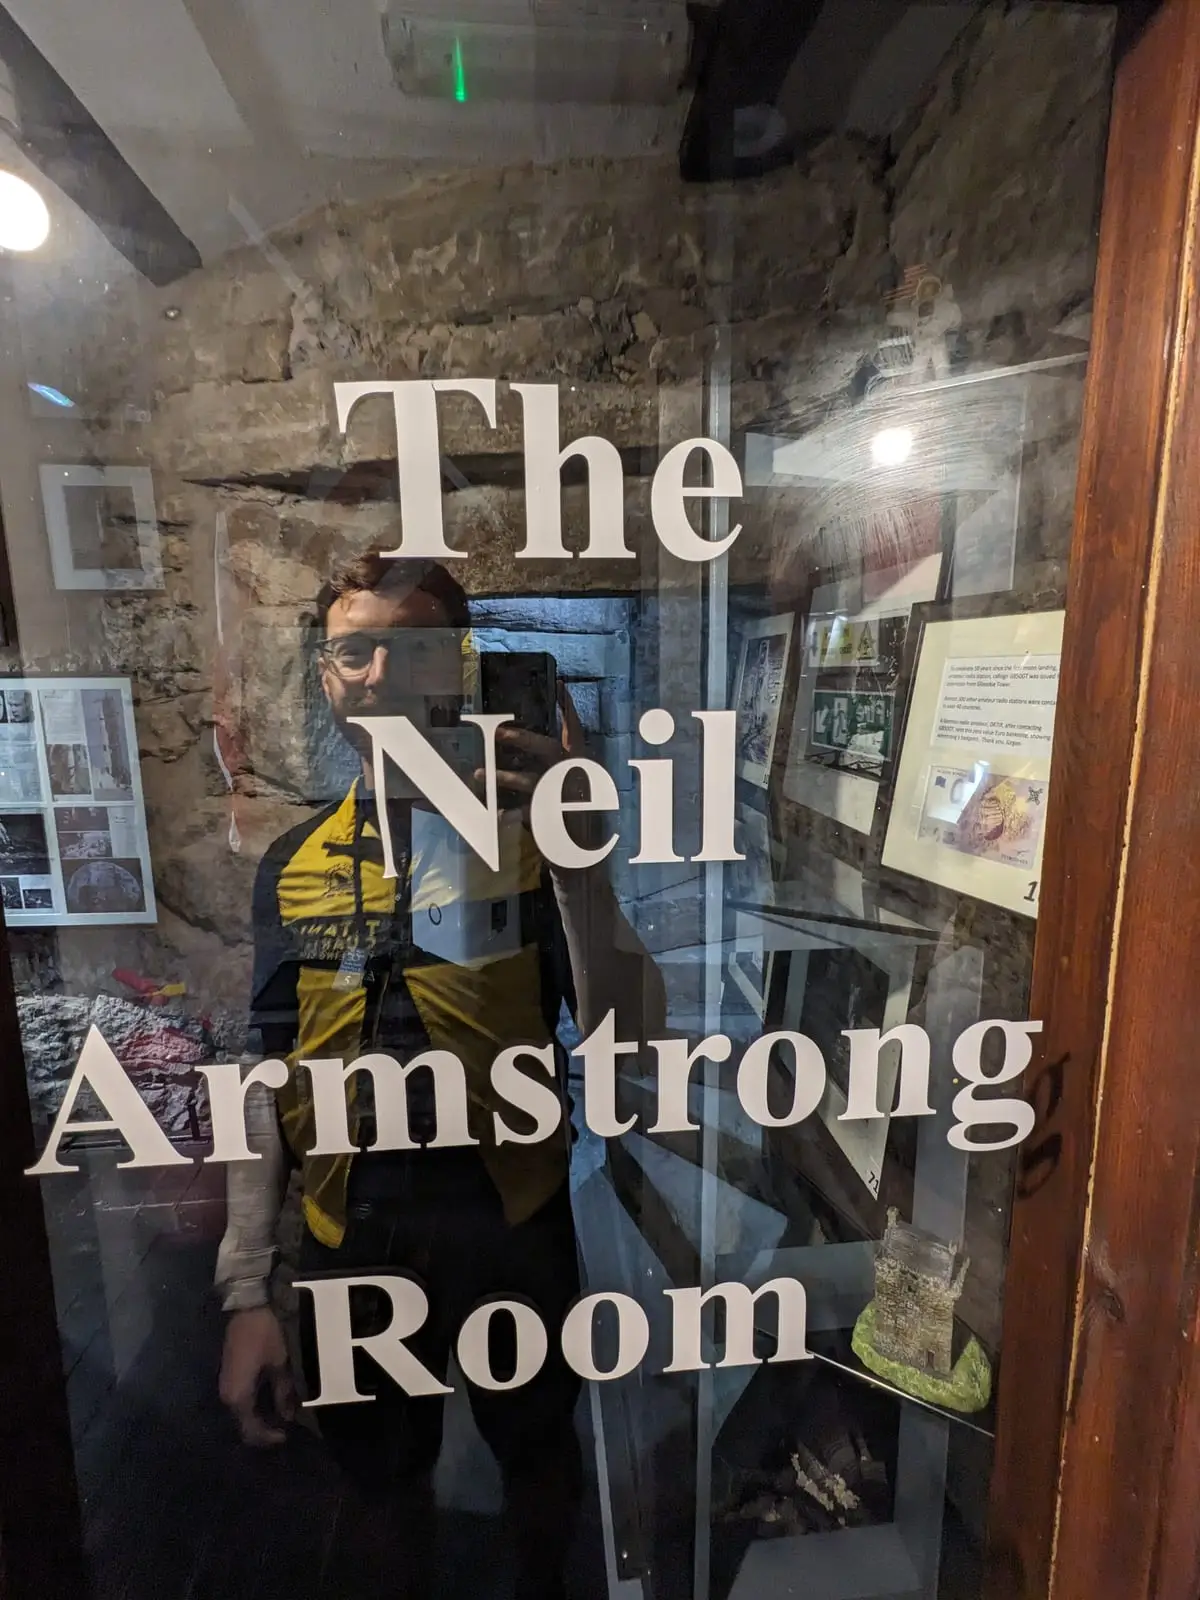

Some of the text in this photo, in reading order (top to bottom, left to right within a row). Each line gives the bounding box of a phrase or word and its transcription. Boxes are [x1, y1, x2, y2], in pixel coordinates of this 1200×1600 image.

[334, 378, 743, 562] The
[347, 711, 746, 877] Neil
[24, 1008, 1043, 1175] Armstrong
[292, 1275, 814, 1408] Room
